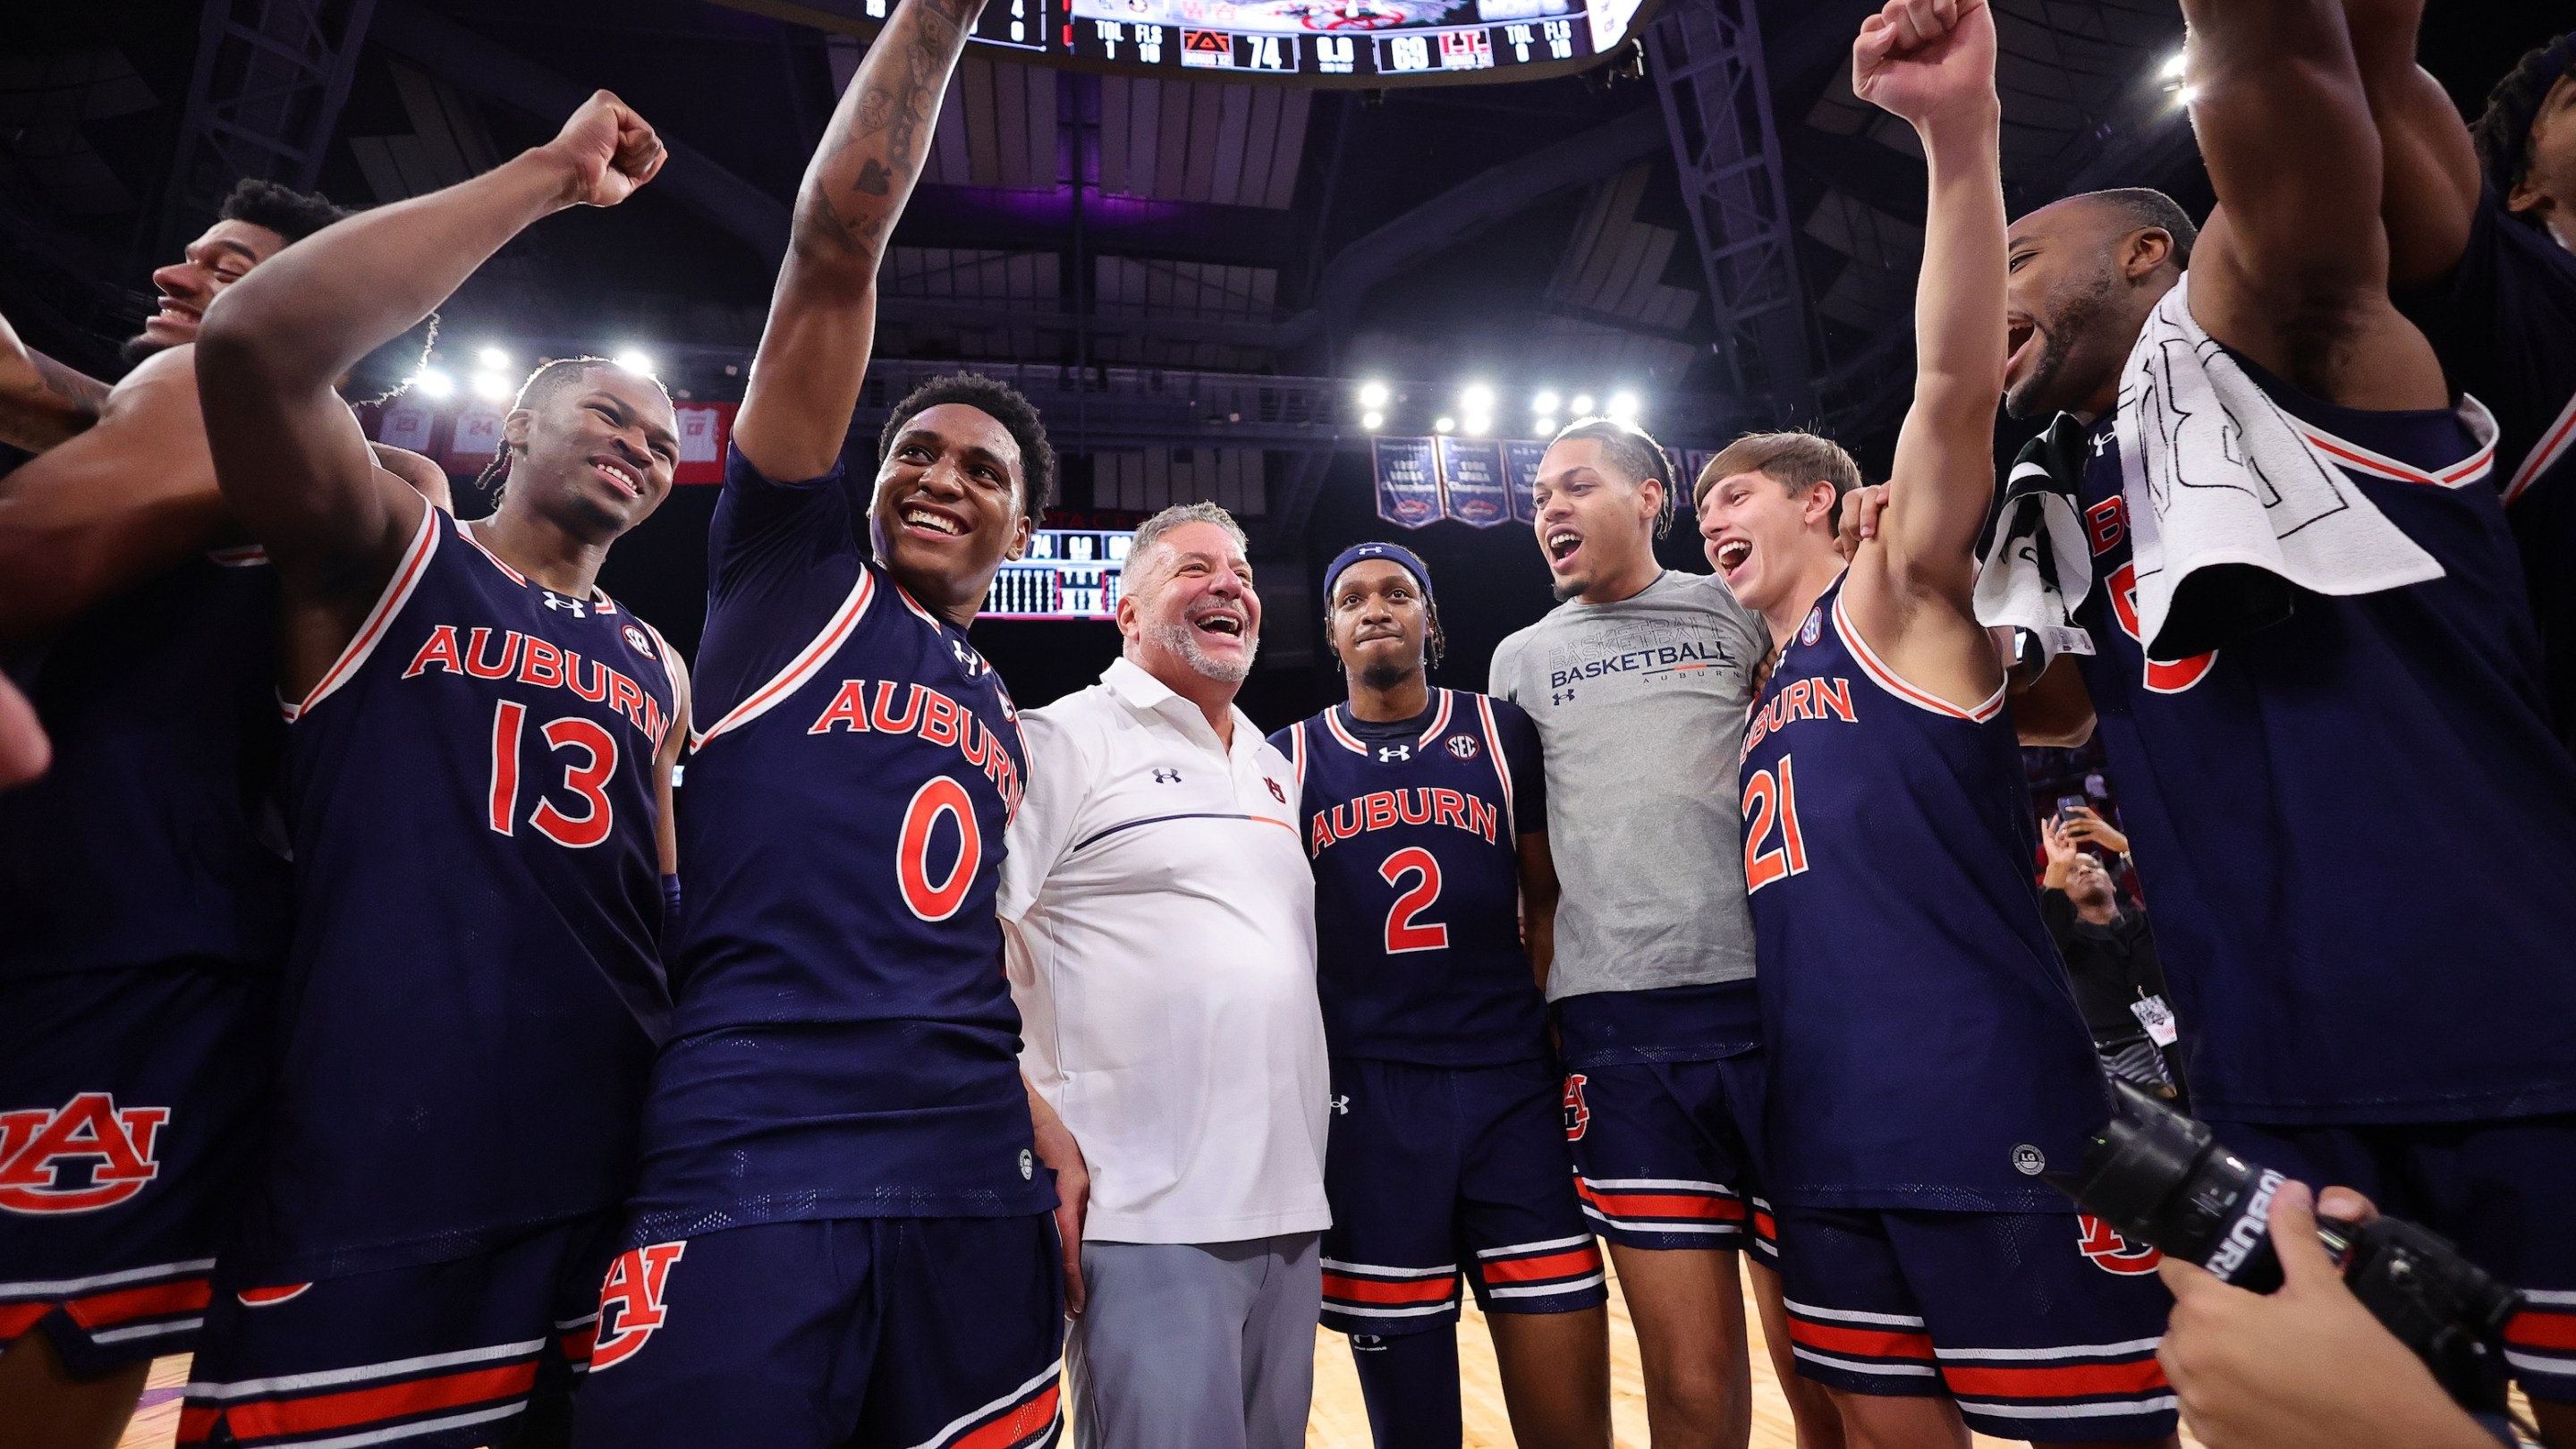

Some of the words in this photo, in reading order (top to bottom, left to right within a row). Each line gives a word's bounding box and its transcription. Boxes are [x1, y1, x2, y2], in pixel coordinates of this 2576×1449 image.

[1095, 20, 1124, 42] TOL
[1134, 24, 1163, 45] FLS
[1504, 23, 1535, 45] TOL
[1543, 20, 1572, 41] FLS
[1105, 40, 1115, 60] 1
[1247, 36, 1282, 69] 74
[1391, 36, 1429, 70] 69
[1030, 535, 1053, 559] 74
[1550, 641, 1735, 689] BASKETBALL
[1642, 671, 1741, 684] AUBURN
[401, 624, 670, 766] AUBURN
[807, 679, 1024, 835] AUBURN
[1448, 734, 1477, 759] SEC
[488, 699, 619, 849] 13
[1312, 787, 1497, 860] AUBURN
[1741, 753, 1809, 895] 21
[896, 775, 982, 922] 0
[1377, 846, 1450, 955] 2
[2021, 1153, 2036, 1162] LG
